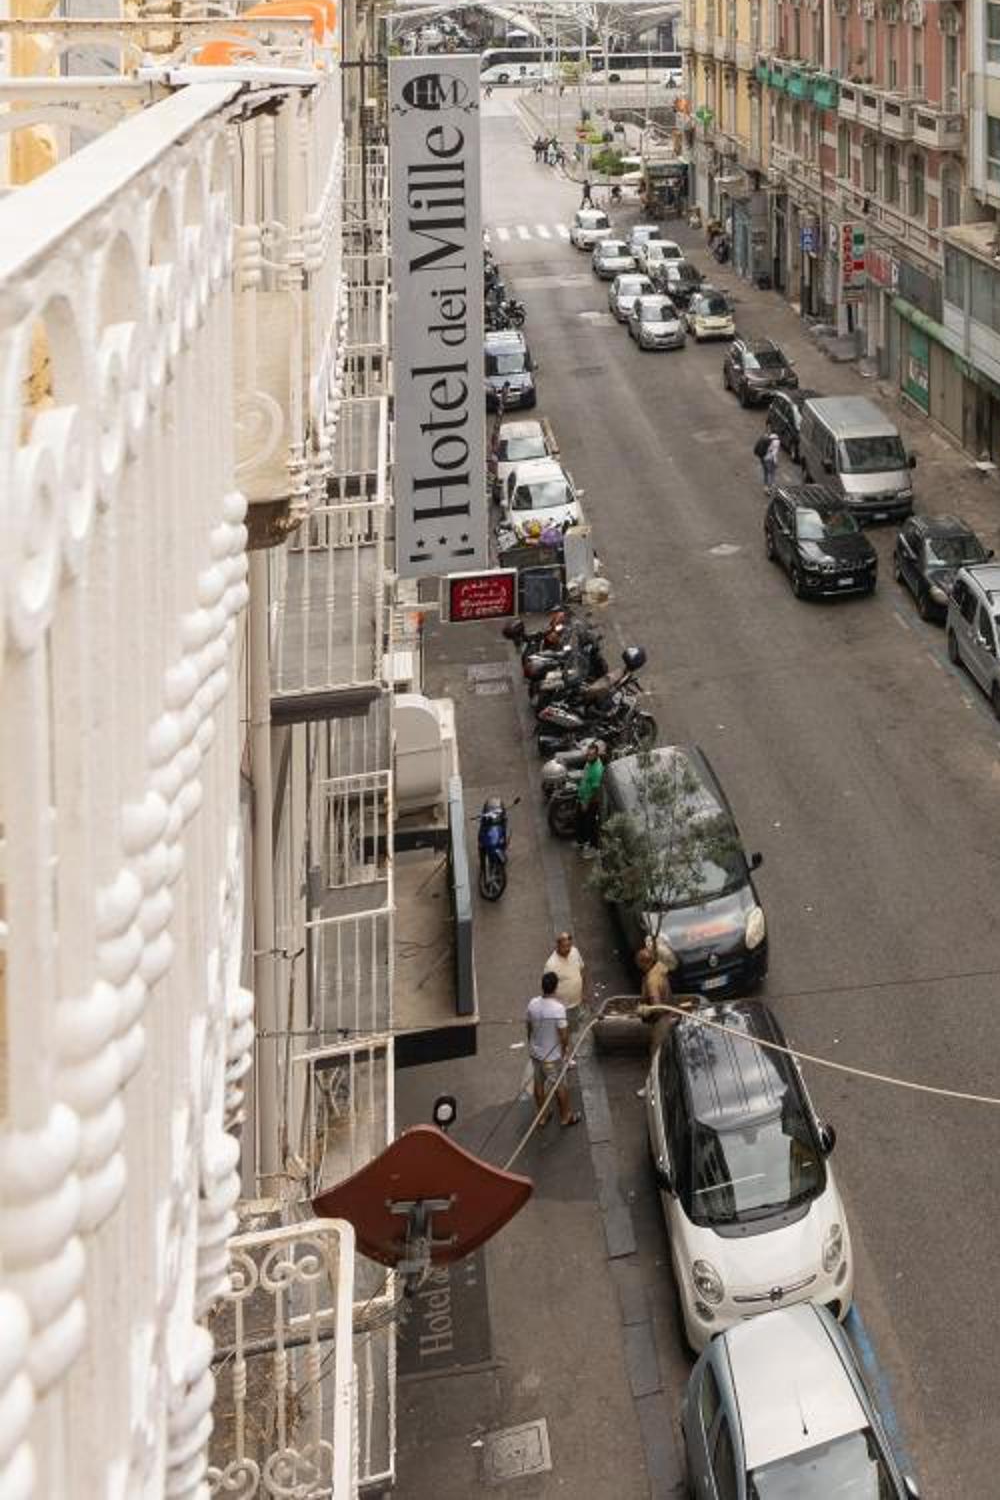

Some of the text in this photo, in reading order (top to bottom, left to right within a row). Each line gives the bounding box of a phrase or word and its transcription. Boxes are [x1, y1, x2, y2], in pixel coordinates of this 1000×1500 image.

[407, 124, 471, 523] Hotel dei Mille
[418, 1286, 453, 1356] Hotel
